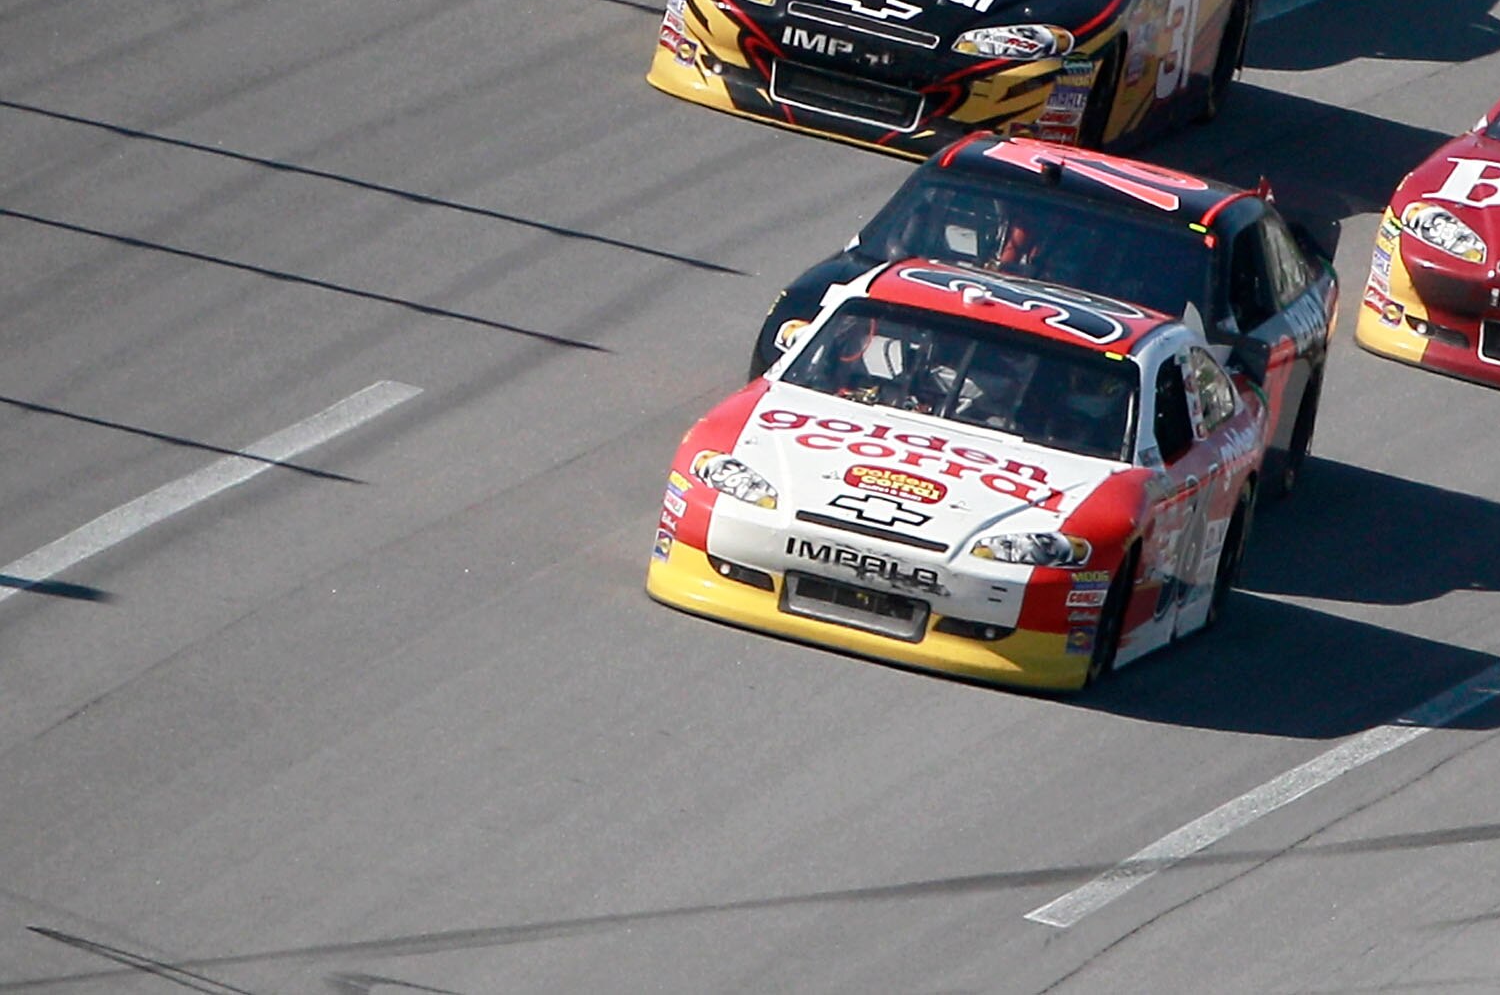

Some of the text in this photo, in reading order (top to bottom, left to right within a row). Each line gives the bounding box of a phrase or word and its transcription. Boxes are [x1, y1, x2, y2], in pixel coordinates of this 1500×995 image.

[758, 410, 1051, 485] golden
[796, 433, 1066, 513] corral
[852, 466, 935, 491] golden
[861, 475, 941, 500] corral
